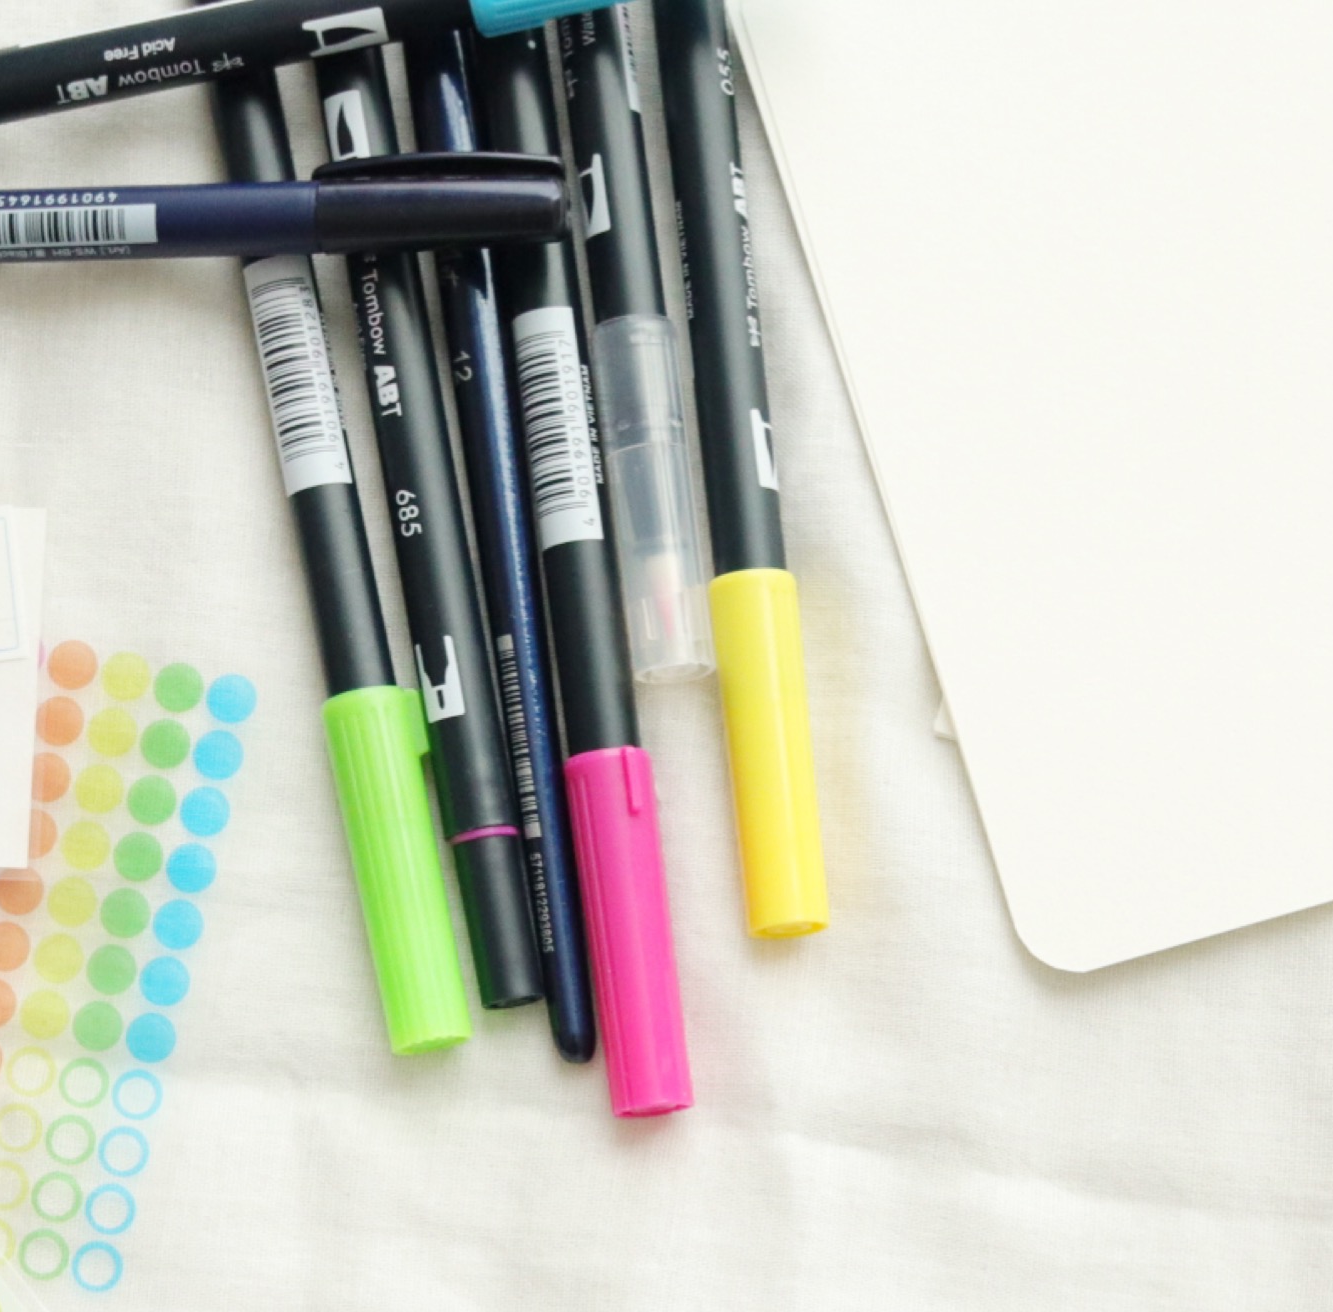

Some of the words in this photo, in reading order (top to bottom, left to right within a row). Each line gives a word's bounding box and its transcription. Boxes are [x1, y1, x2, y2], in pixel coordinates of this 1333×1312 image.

[102, 42, 139, 65] Free
[139, 35, 177, 58] Acid
[713, 44, 736, 96] 055
[53, 73, 111, 105] ABT
[115, 56, 205, 89] Tombow
[726, 160, 751, 219] ABT
[733, 224, 762, 309] Tombow
[356, 269, 392, 358] Tombow
[371, 362, 404, 419] ABT
[450, 349, 475, 385] 12
[392, 487, 423, 538] 685
